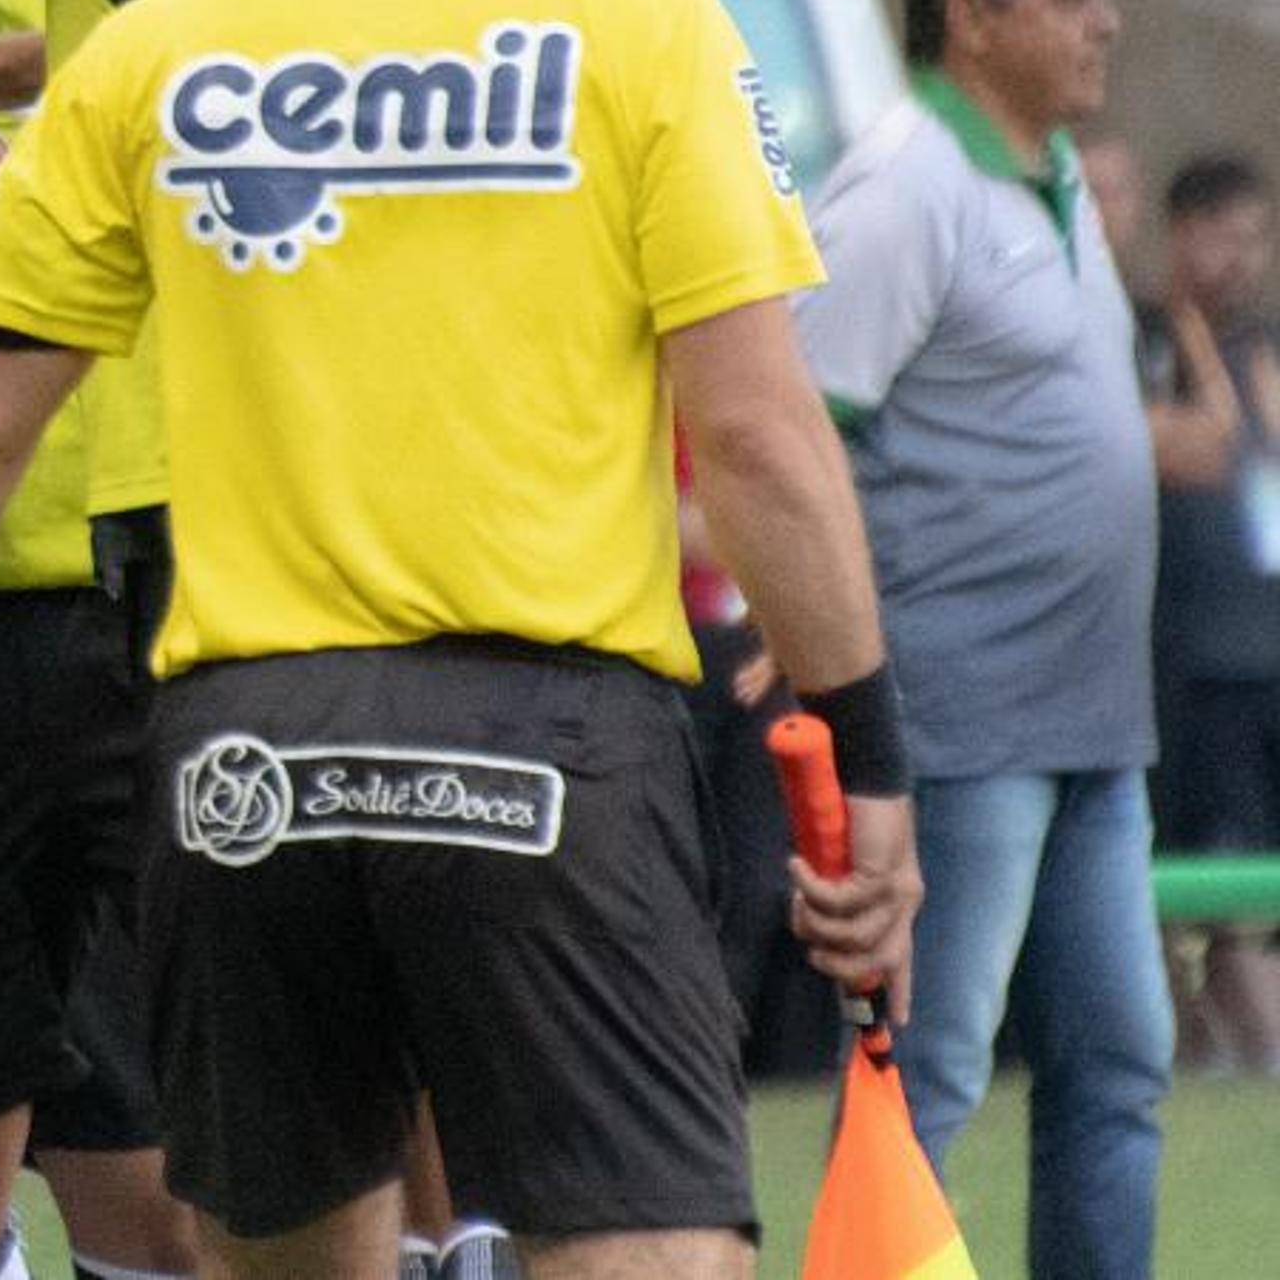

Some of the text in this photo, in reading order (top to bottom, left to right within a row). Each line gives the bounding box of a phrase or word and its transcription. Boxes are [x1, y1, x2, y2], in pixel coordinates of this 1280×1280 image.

[172, 29, 572, 154] cemil
[738, 66, 794, 196] cemil
[413, 770, 537, 829] Doces
